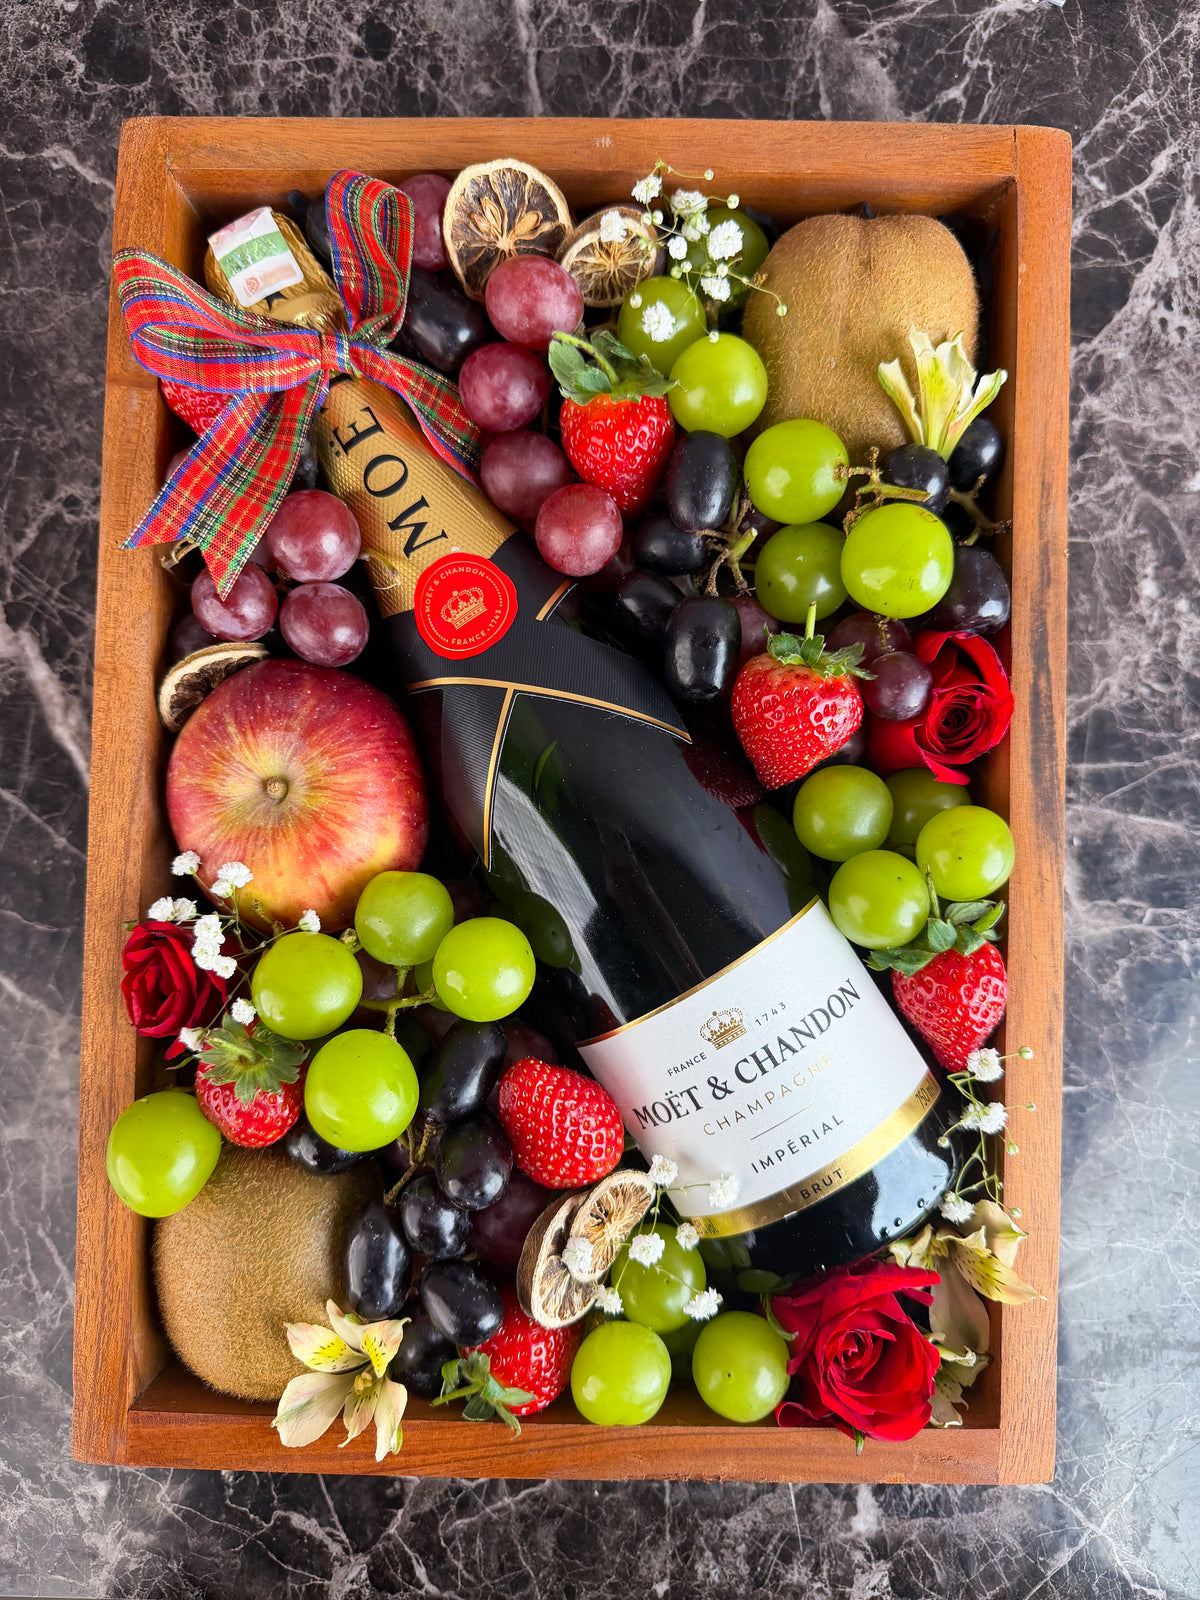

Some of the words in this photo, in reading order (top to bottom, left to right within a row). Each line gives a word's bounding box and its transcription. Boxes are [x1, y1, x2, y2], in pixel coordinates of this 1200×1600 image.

[440, 566, 486, 580] CHANDON
[451, 630, 487, 645] FRANCE
[632, 1085, 704, 1130] MOËT
[707, 1075, 735, 1101] &
[734, 978, 861, 1084] CHANDON
[667, 1051, 707, 1077] FRANCE
[754, 1001, 787, 1027] 1743
[703, 1052, 833, 1136] CHAMPAGNE
[750, 1115, 844, 1174] IMPÉRIAL
[800, 1167, 843, 1201] BRUT
